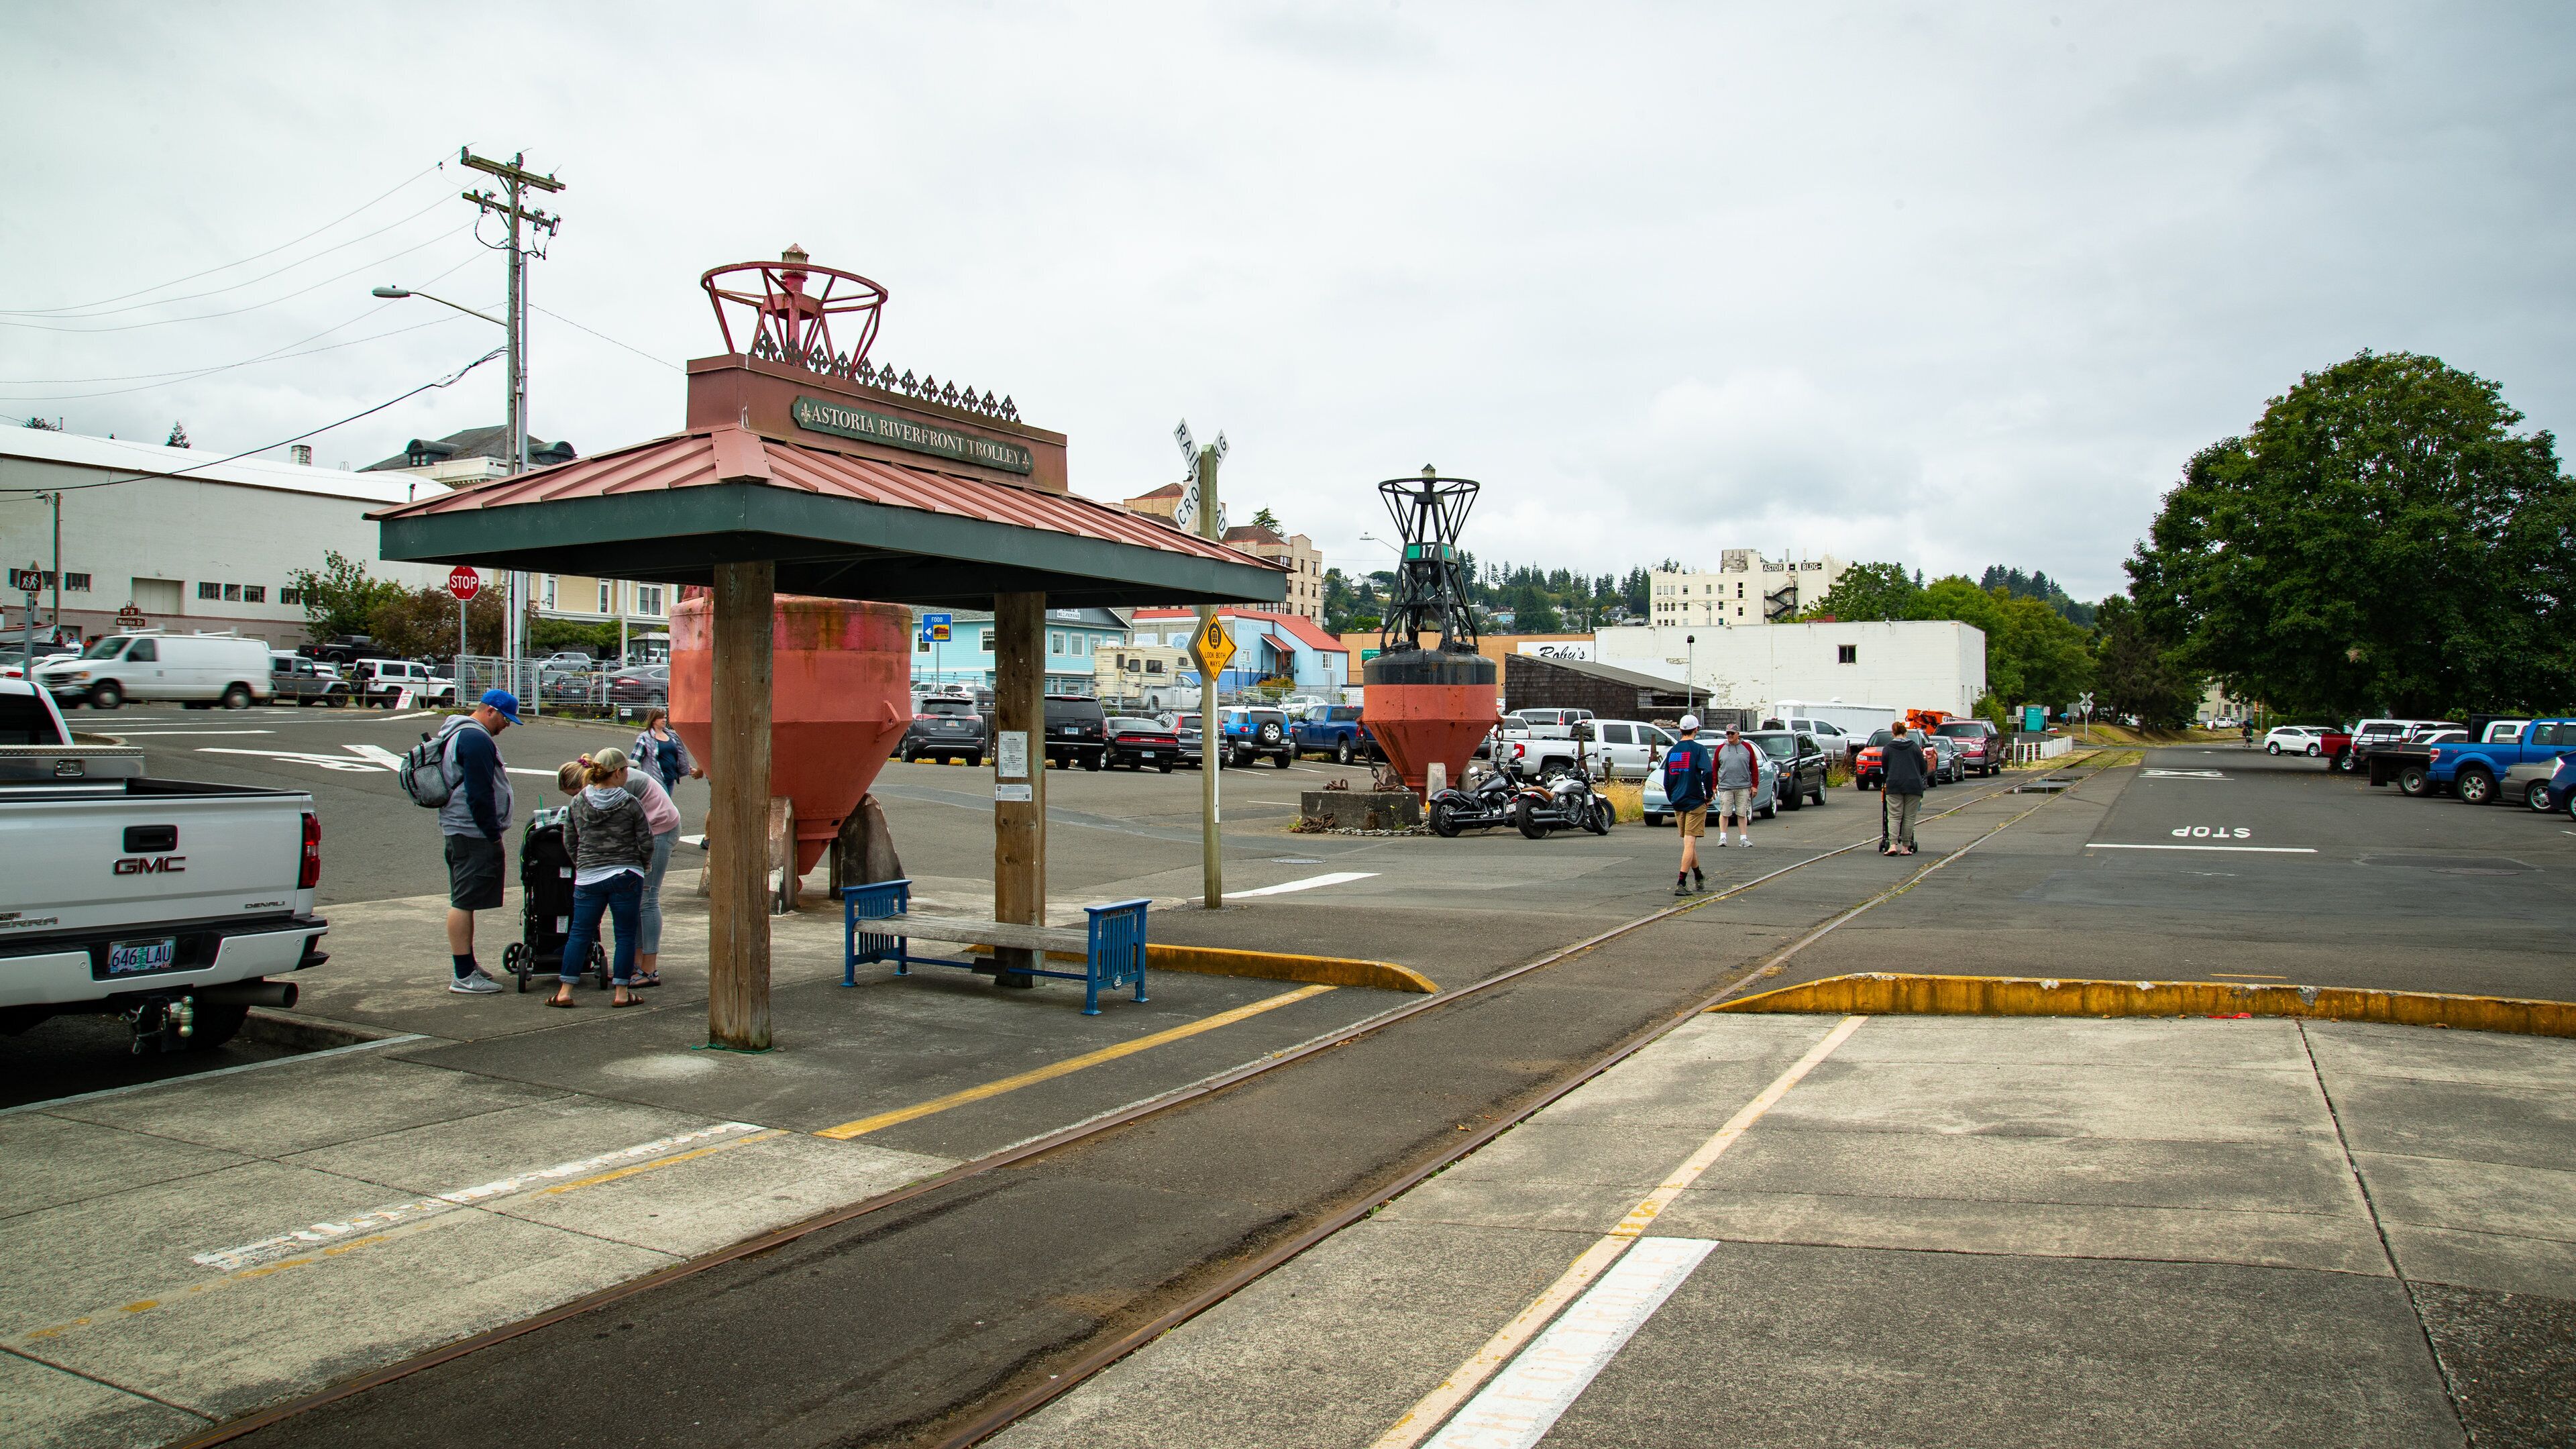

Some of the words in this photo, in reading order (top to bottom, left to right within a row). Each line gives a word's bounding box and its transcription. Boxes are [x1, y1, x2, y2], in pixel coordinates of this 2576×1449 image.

[812, 405, 875, 433] ASTORIA
[879, 419, 964, 452] RIVERFRONT
[967, 439, 1020, 466] TROLLEY
[1177, 423, 1226, 532] RAILAD
[1422, 544, 1435, 559] 17
[1448, 546, 1454, 559] 17
[451, 575, 477, 589] STOP
[1539, 645, 1586, 660] Roby's
[2171, 826, 2251, 839] STOP
[113, 855, 186, 875] GMC
[244, 901, 285, 909] DENALI
[112, 949, 137, 967] 646
[146, 945, 172, 964] LAU
